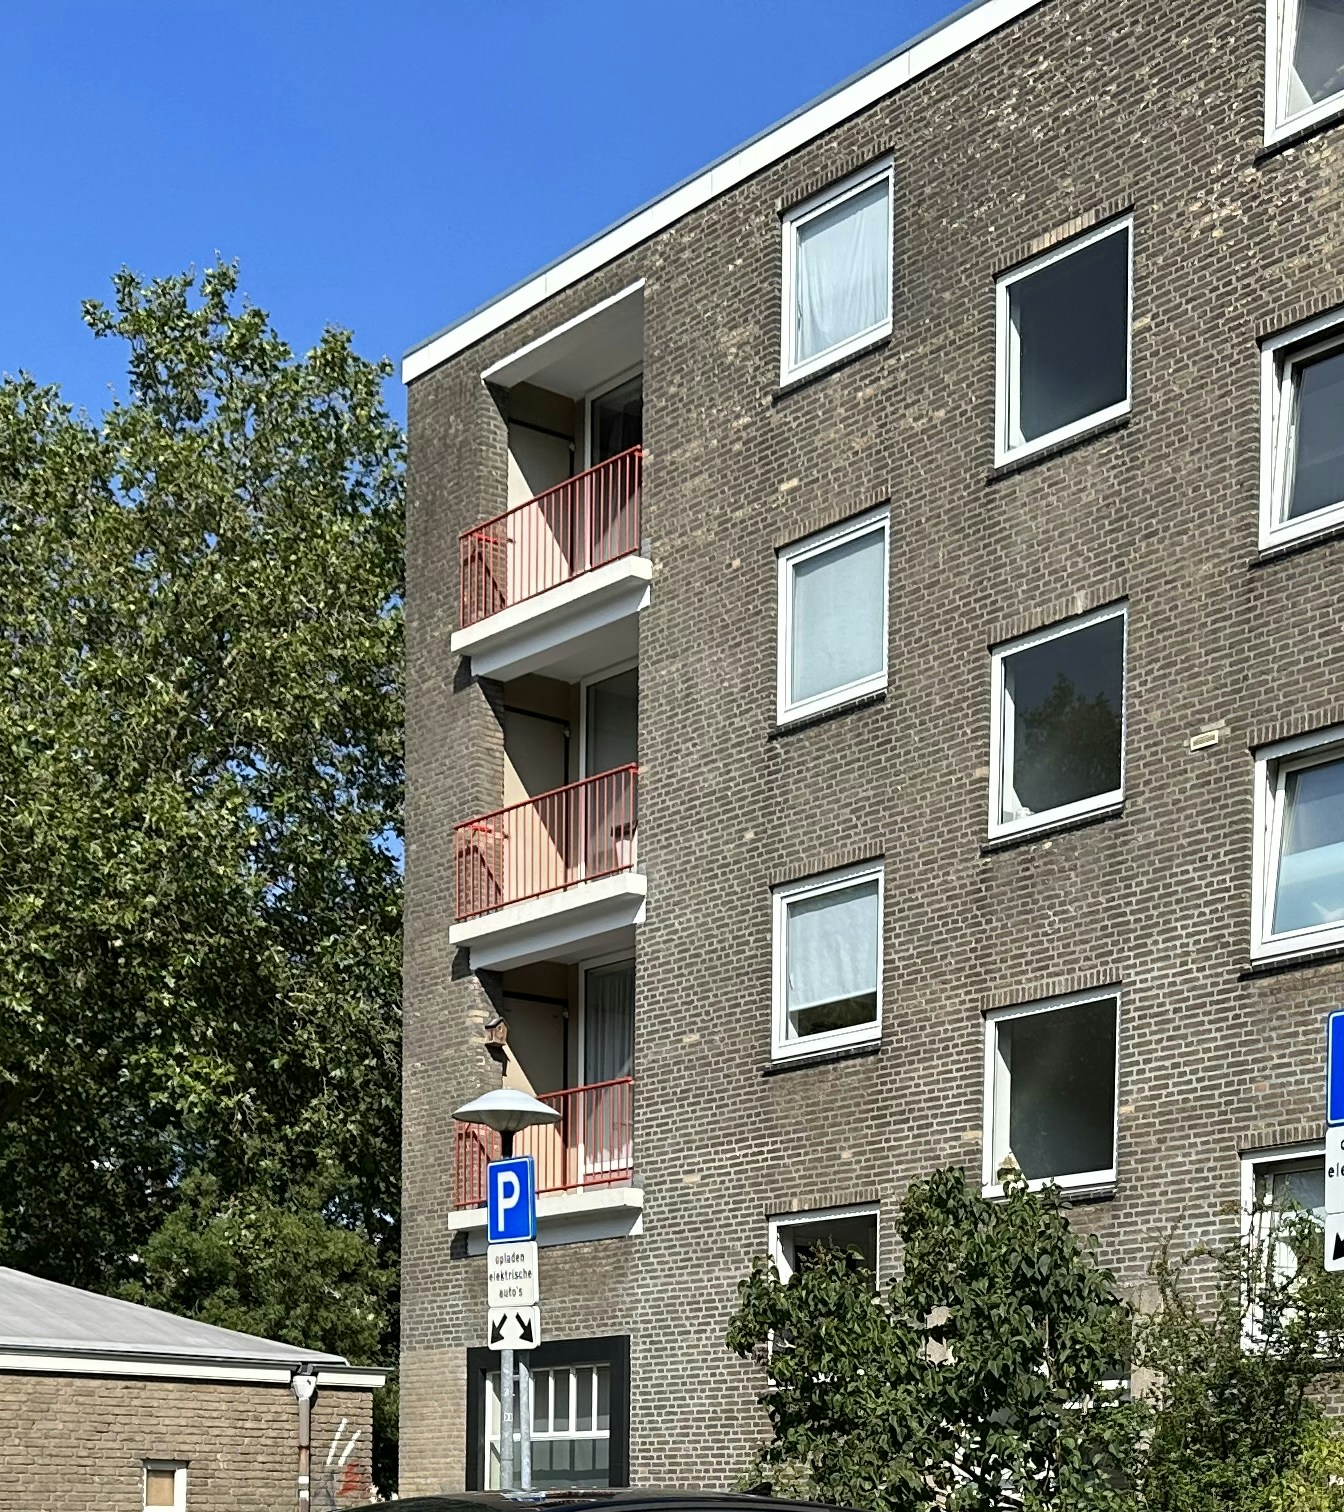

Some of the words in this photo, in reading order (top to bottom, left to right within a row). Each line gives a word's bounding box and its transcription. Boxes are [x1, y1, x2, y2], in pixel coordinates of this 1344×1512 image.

[497, 1170, 520, 1232] P
[495, 1252, 525, 1266] opladen
[489, 1268, 532, 1282] elektrische
[499, 1286, 523, 1298] auto's
